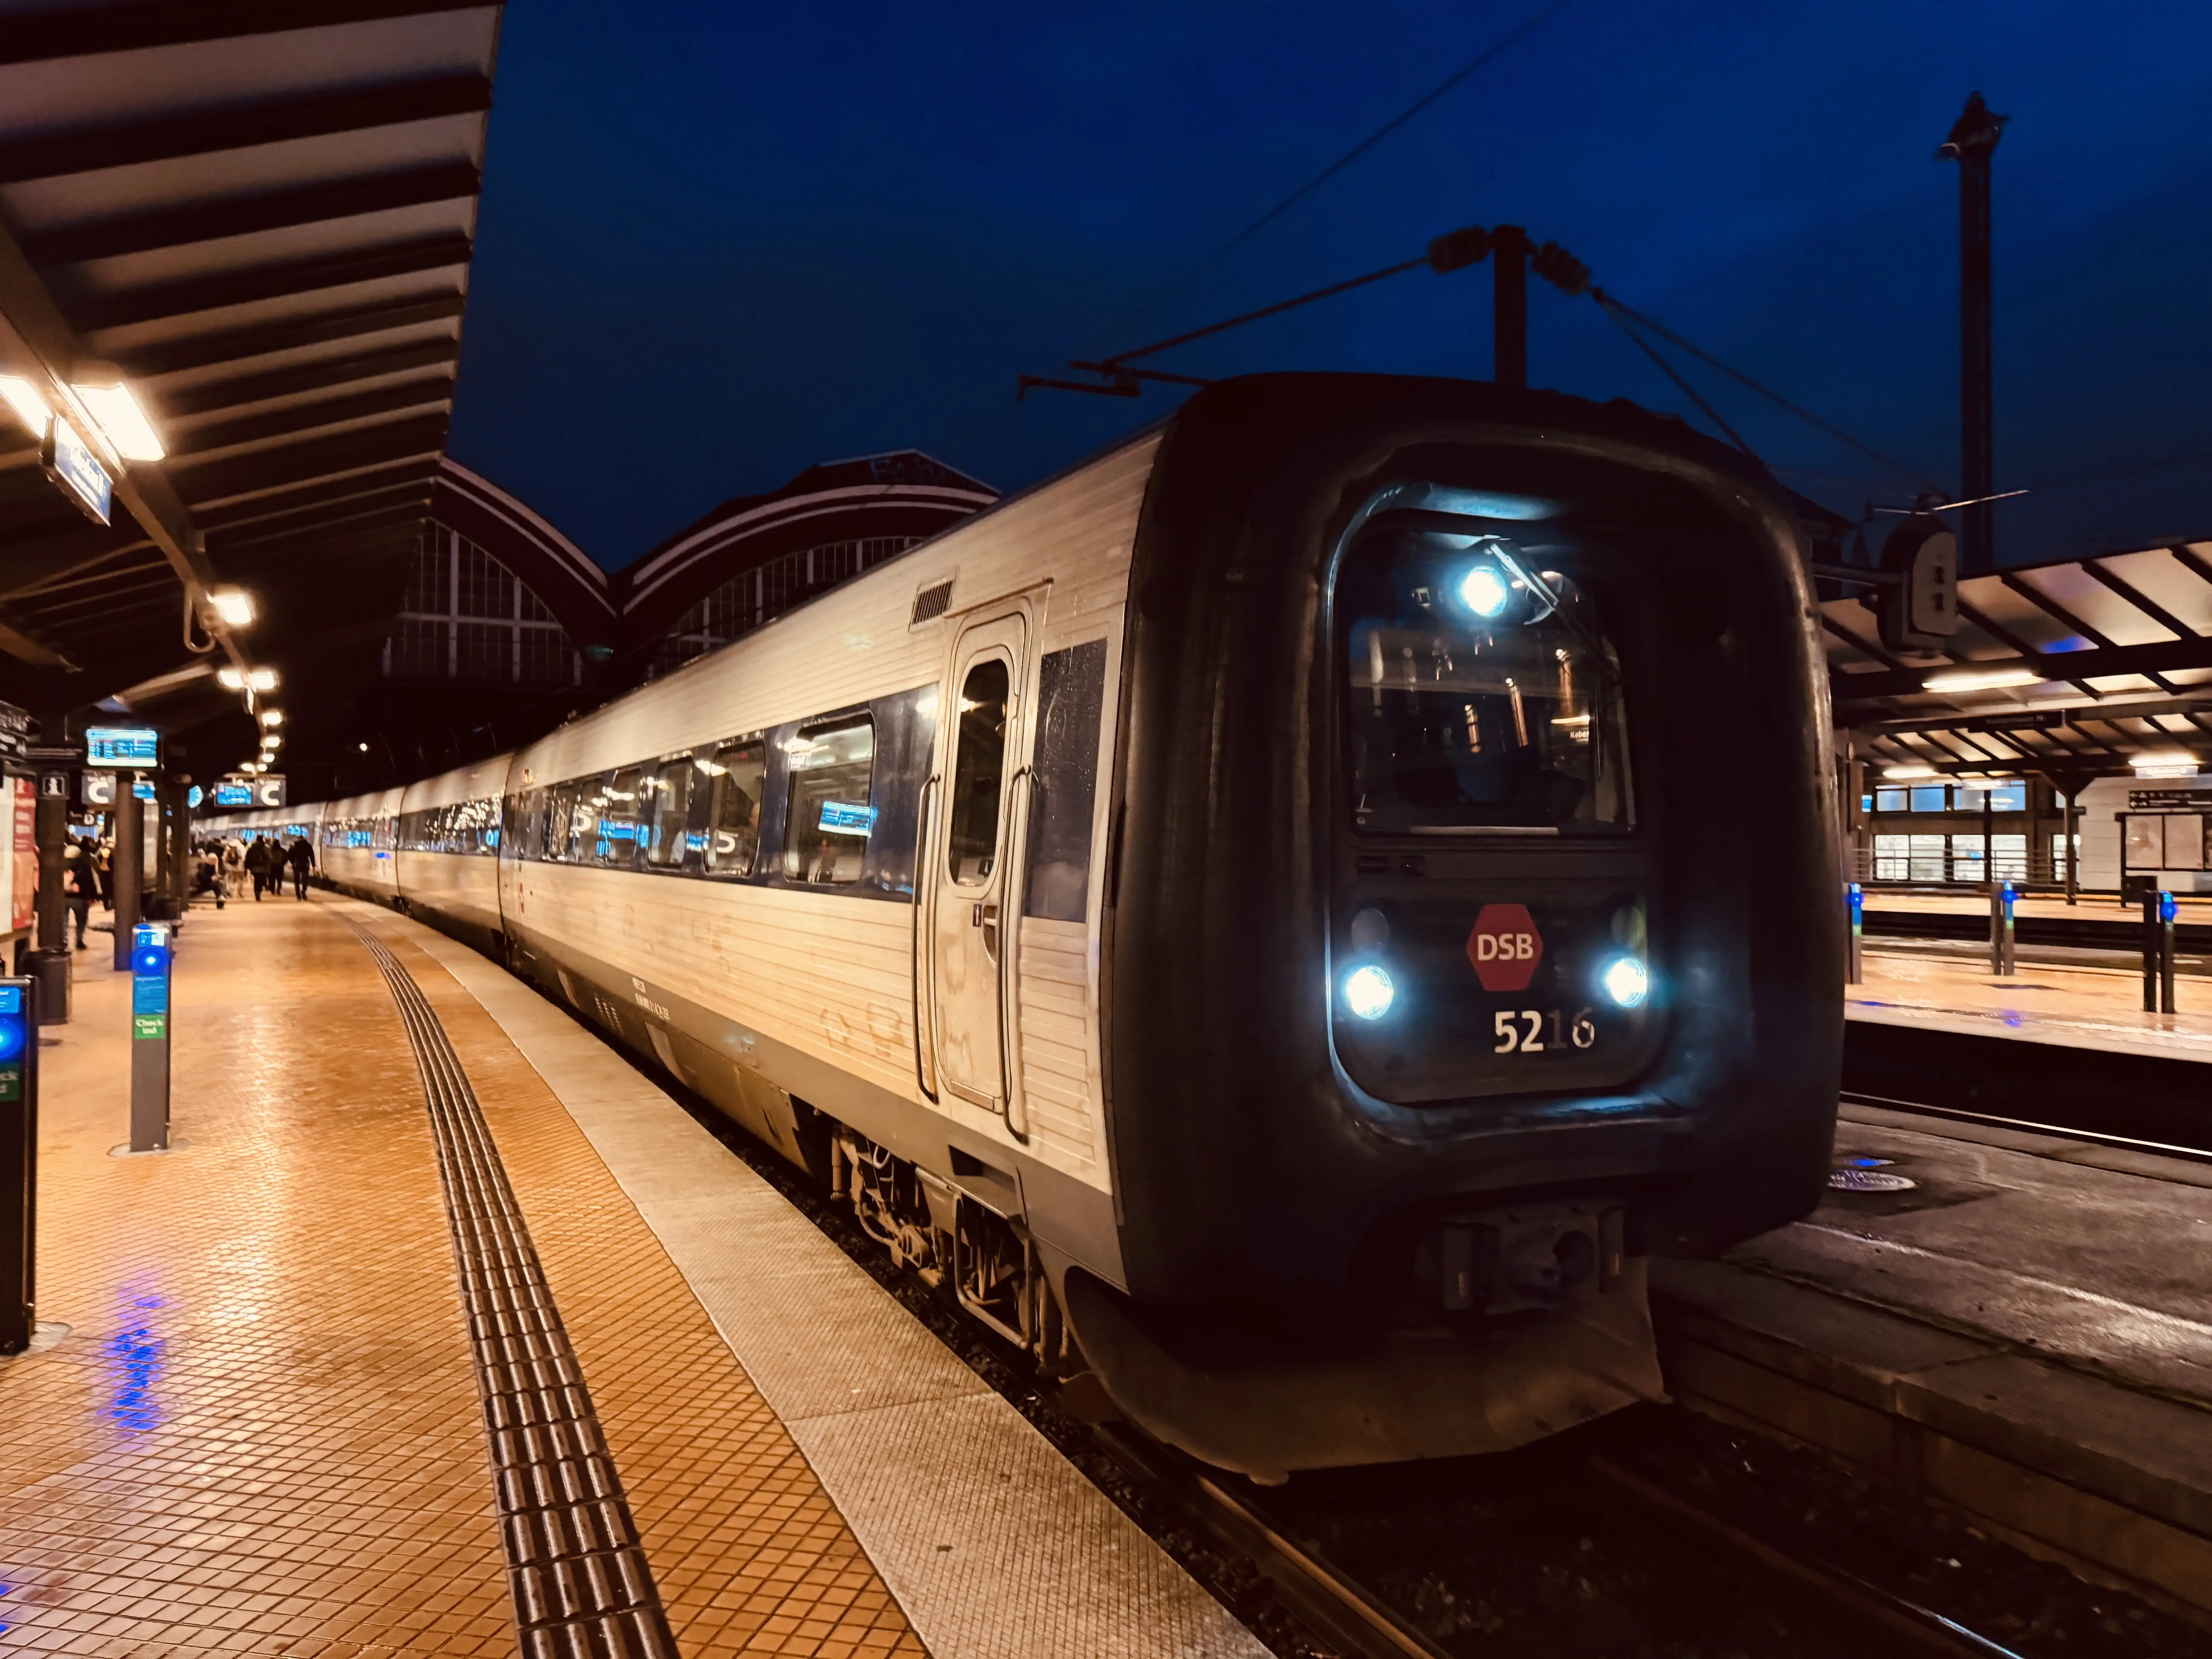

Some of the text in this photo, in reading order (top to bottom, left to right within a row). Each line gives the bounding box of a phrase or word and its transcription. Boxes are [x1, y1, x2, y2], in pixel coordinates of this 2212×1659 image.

[88, 781, 109, 804] C
[261, 785, 280, 805] C
[1477, 933, 1534, 961] DSB
[1494, 1007, 1595, 1054] 5216
